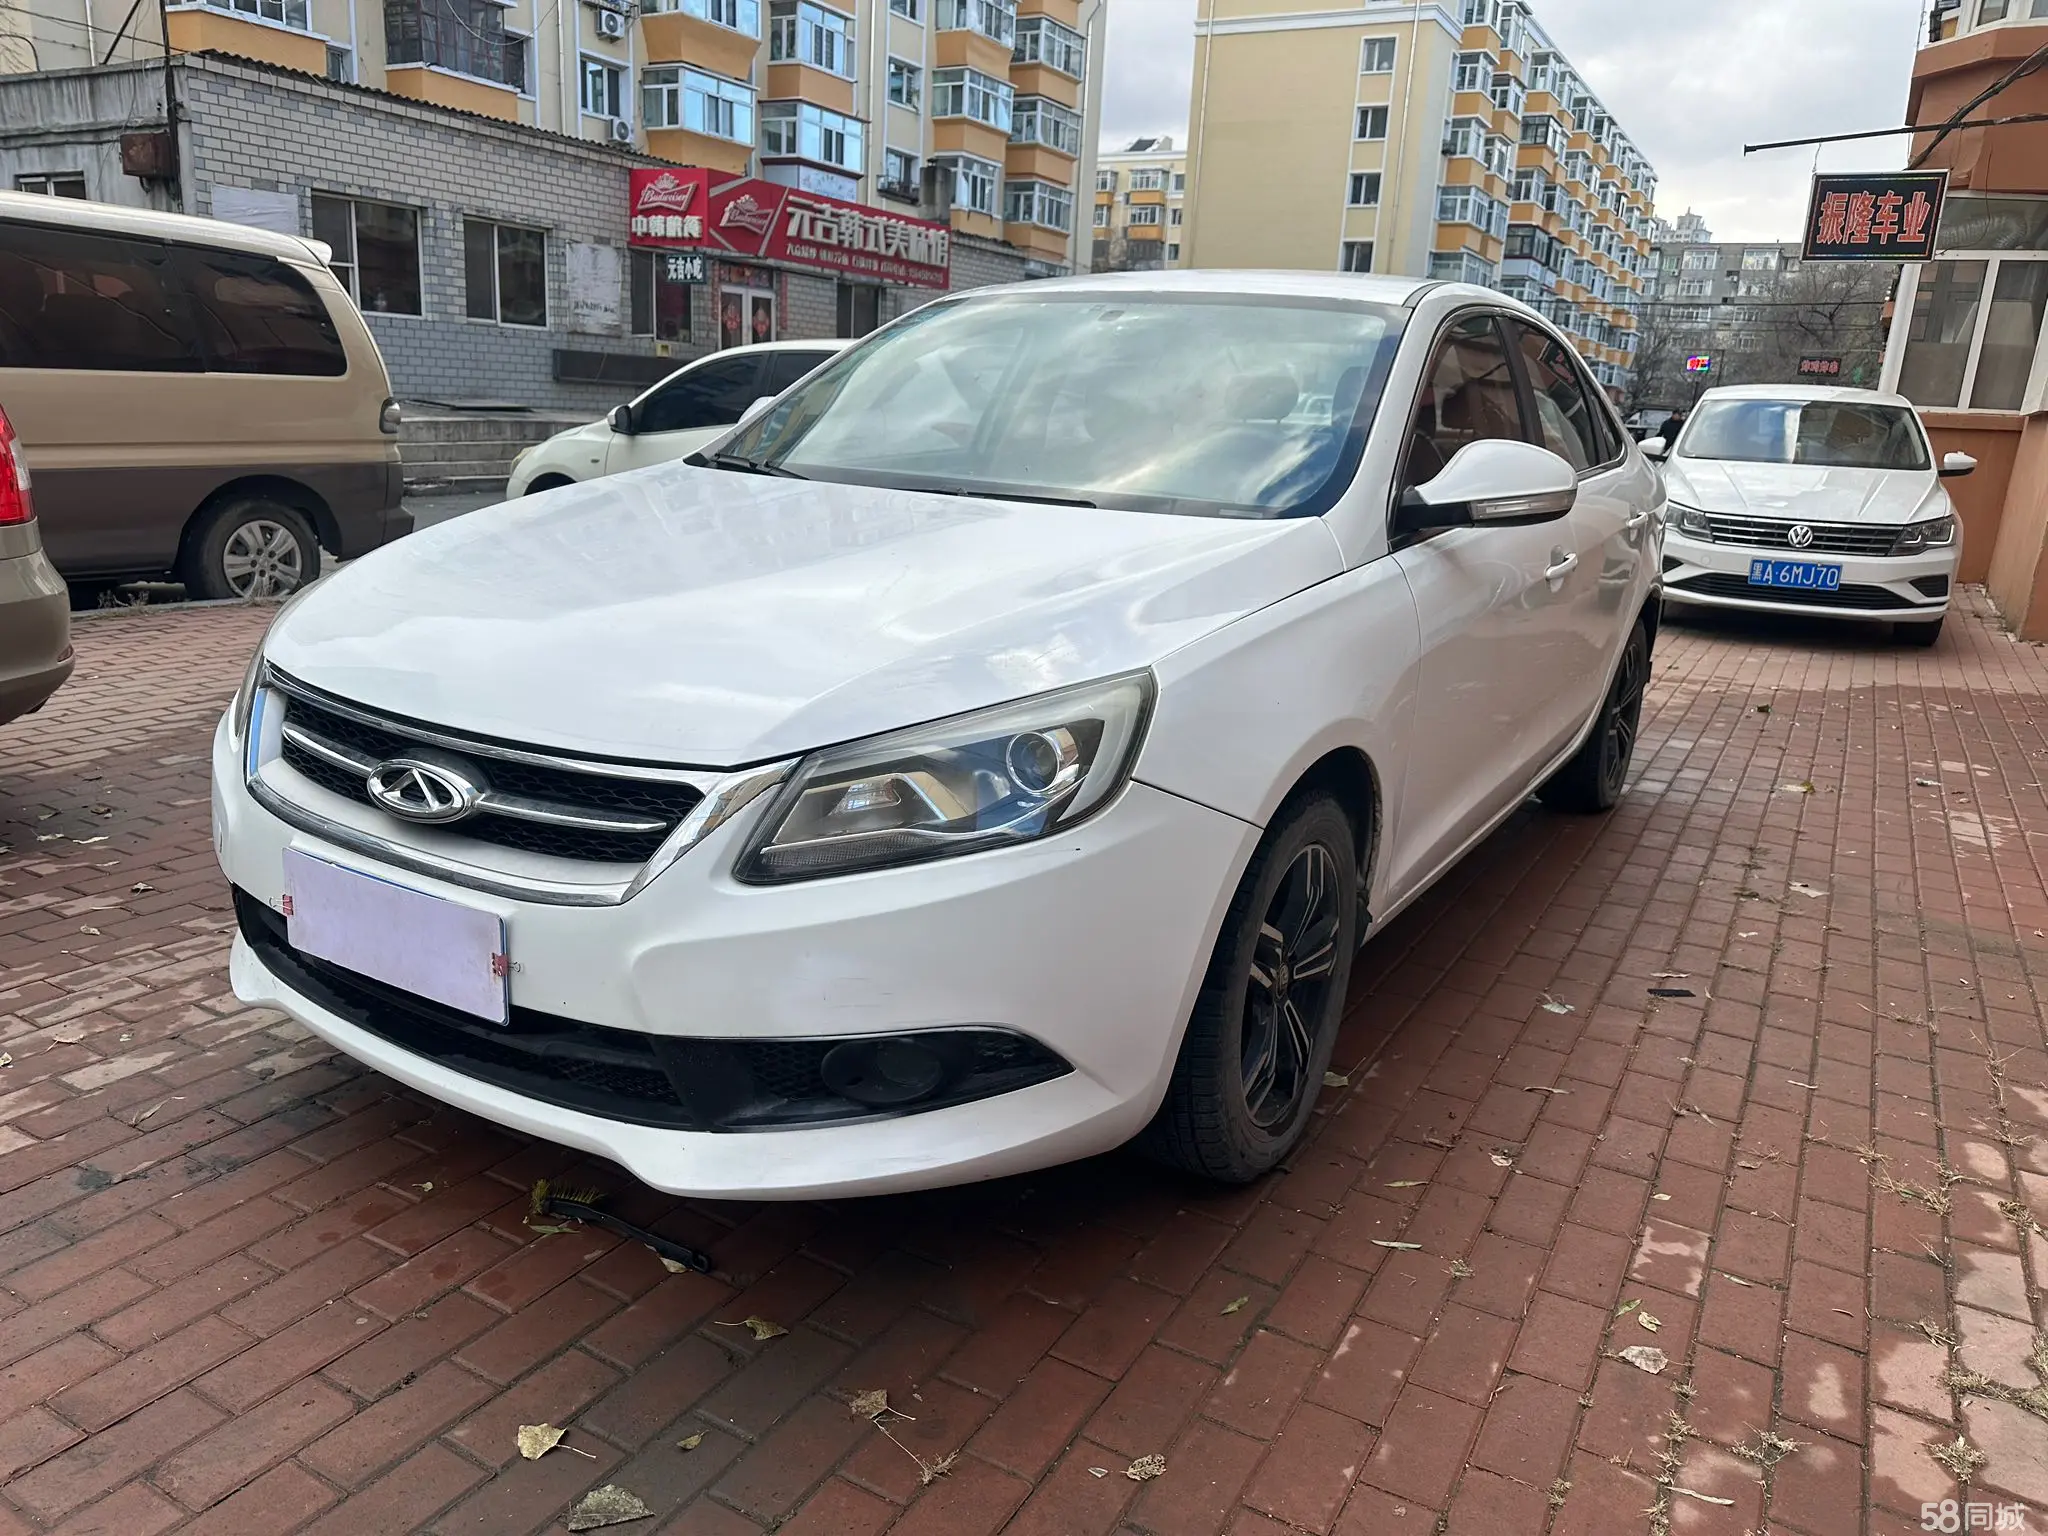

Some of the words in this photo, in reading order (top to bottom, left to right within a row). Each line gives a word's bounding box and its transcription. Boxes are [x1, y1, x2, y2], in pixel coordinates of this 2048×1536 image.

[642, 189, 690, 202] Budweiser
[786, 195, 950, 267] 元吉韩式美味馆
[1816, 190, 1931, 245] 振隆车业
[667, 257, 703, 281] 元吉小吃
